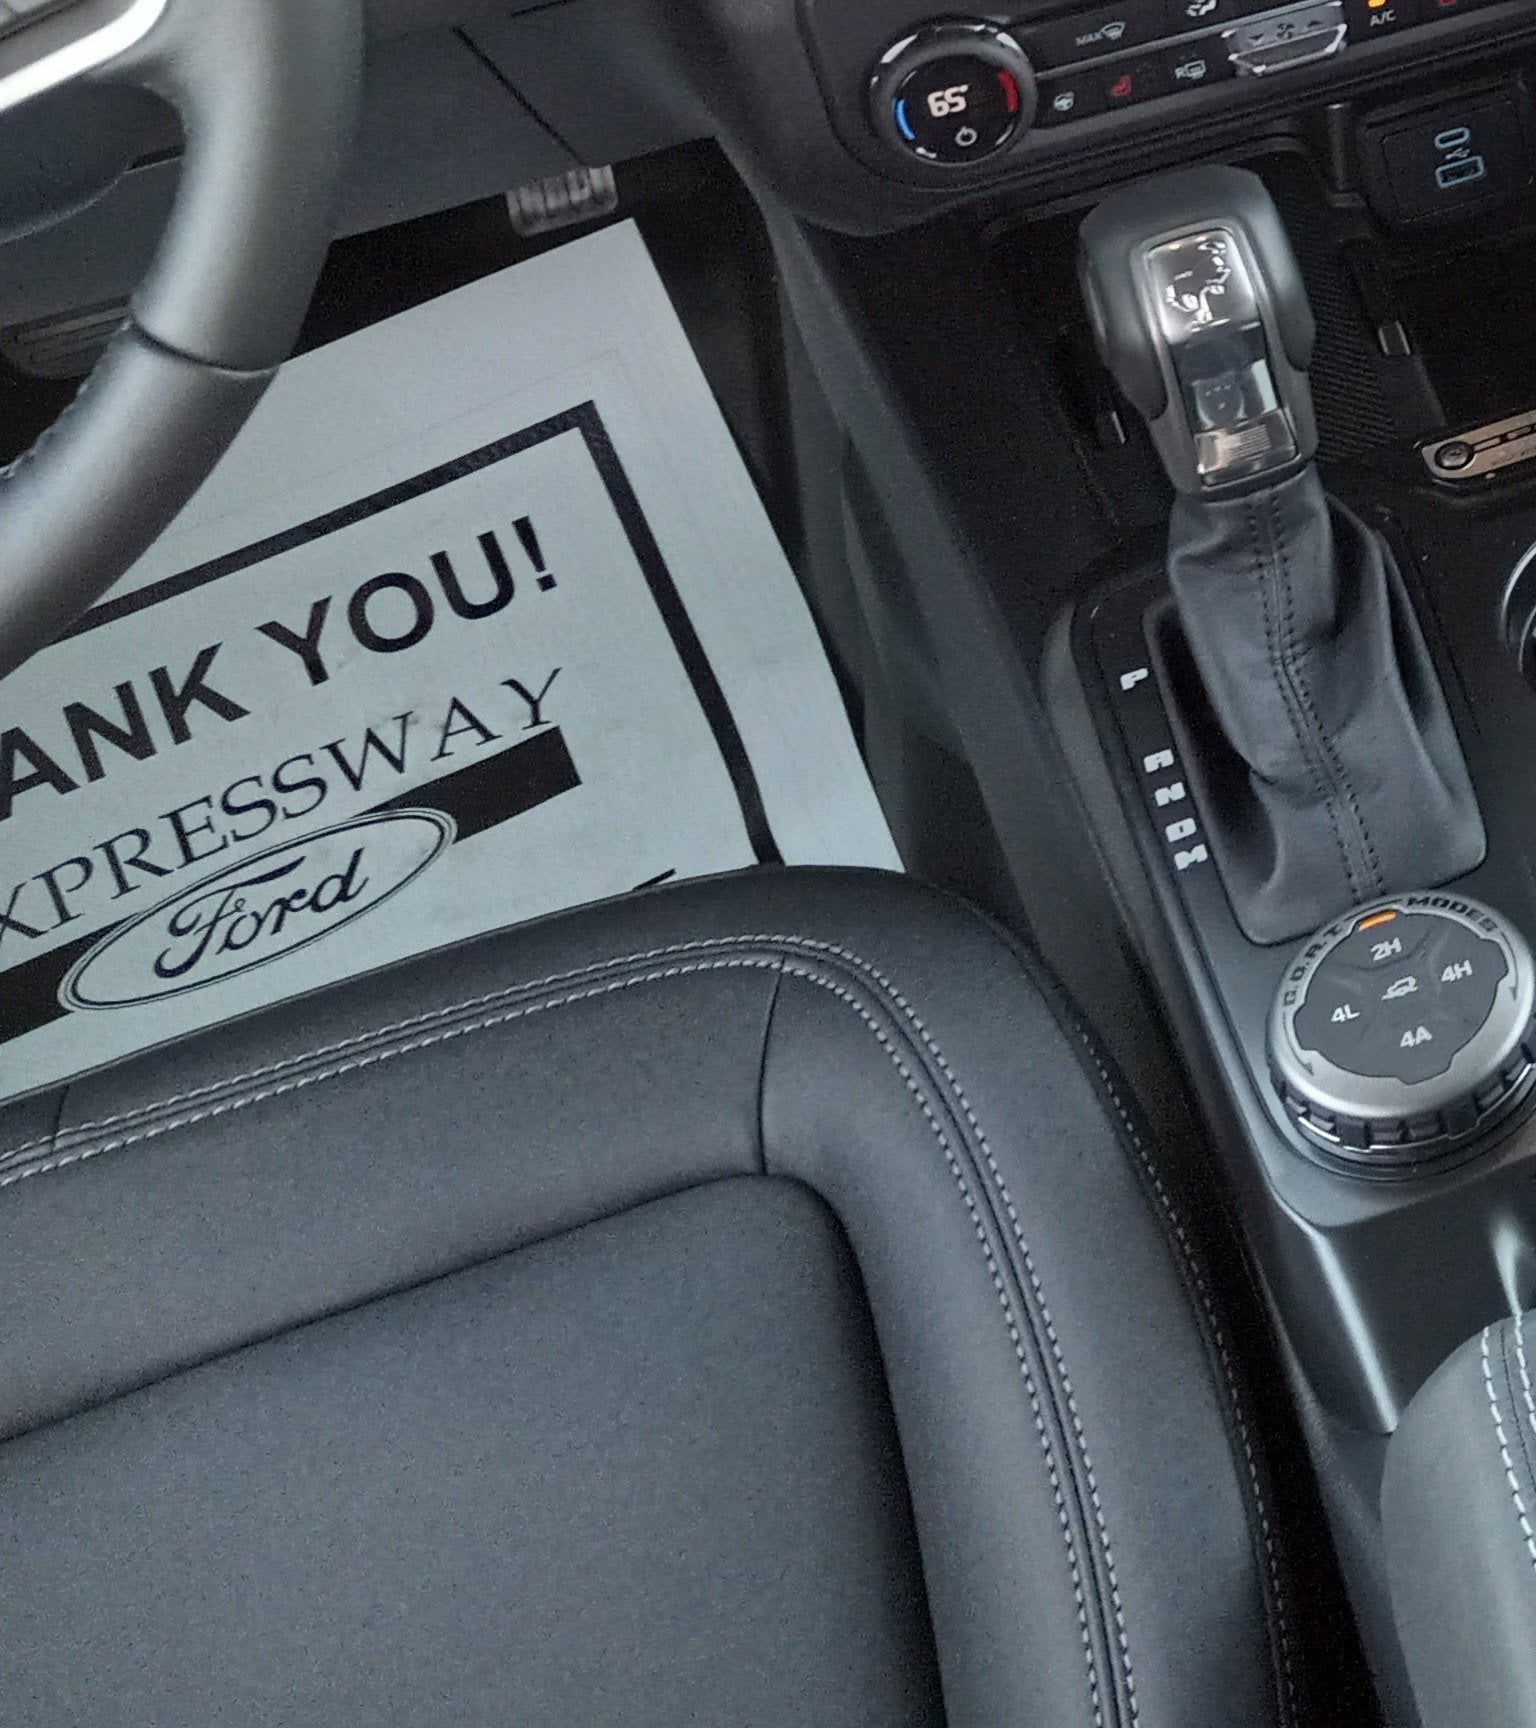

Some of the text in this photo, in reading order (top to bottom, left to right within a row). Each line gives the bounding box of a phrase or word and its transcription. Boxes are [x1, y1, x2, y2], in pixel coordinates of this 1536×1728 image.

[1369, 9, 1396, 27] A/C
[1075, 31, 1101, 47] MAX
[257, 514, 560, 686] YOU!
[1120, 668, 1149, 691] P
[1155, 782, 1186, 807] N
[1174, 844, 1208, 870] M
[152, 847, 368, 980] Ford
[1406, 896, 1498, 933] MODES
[1370, 937, 1402, 962] 2H
[1441, 960, 1473, 983] 4H
[1331, 1003, 1360, 1023] 4L
[1400, 1025, 1433, 1048] 4A
